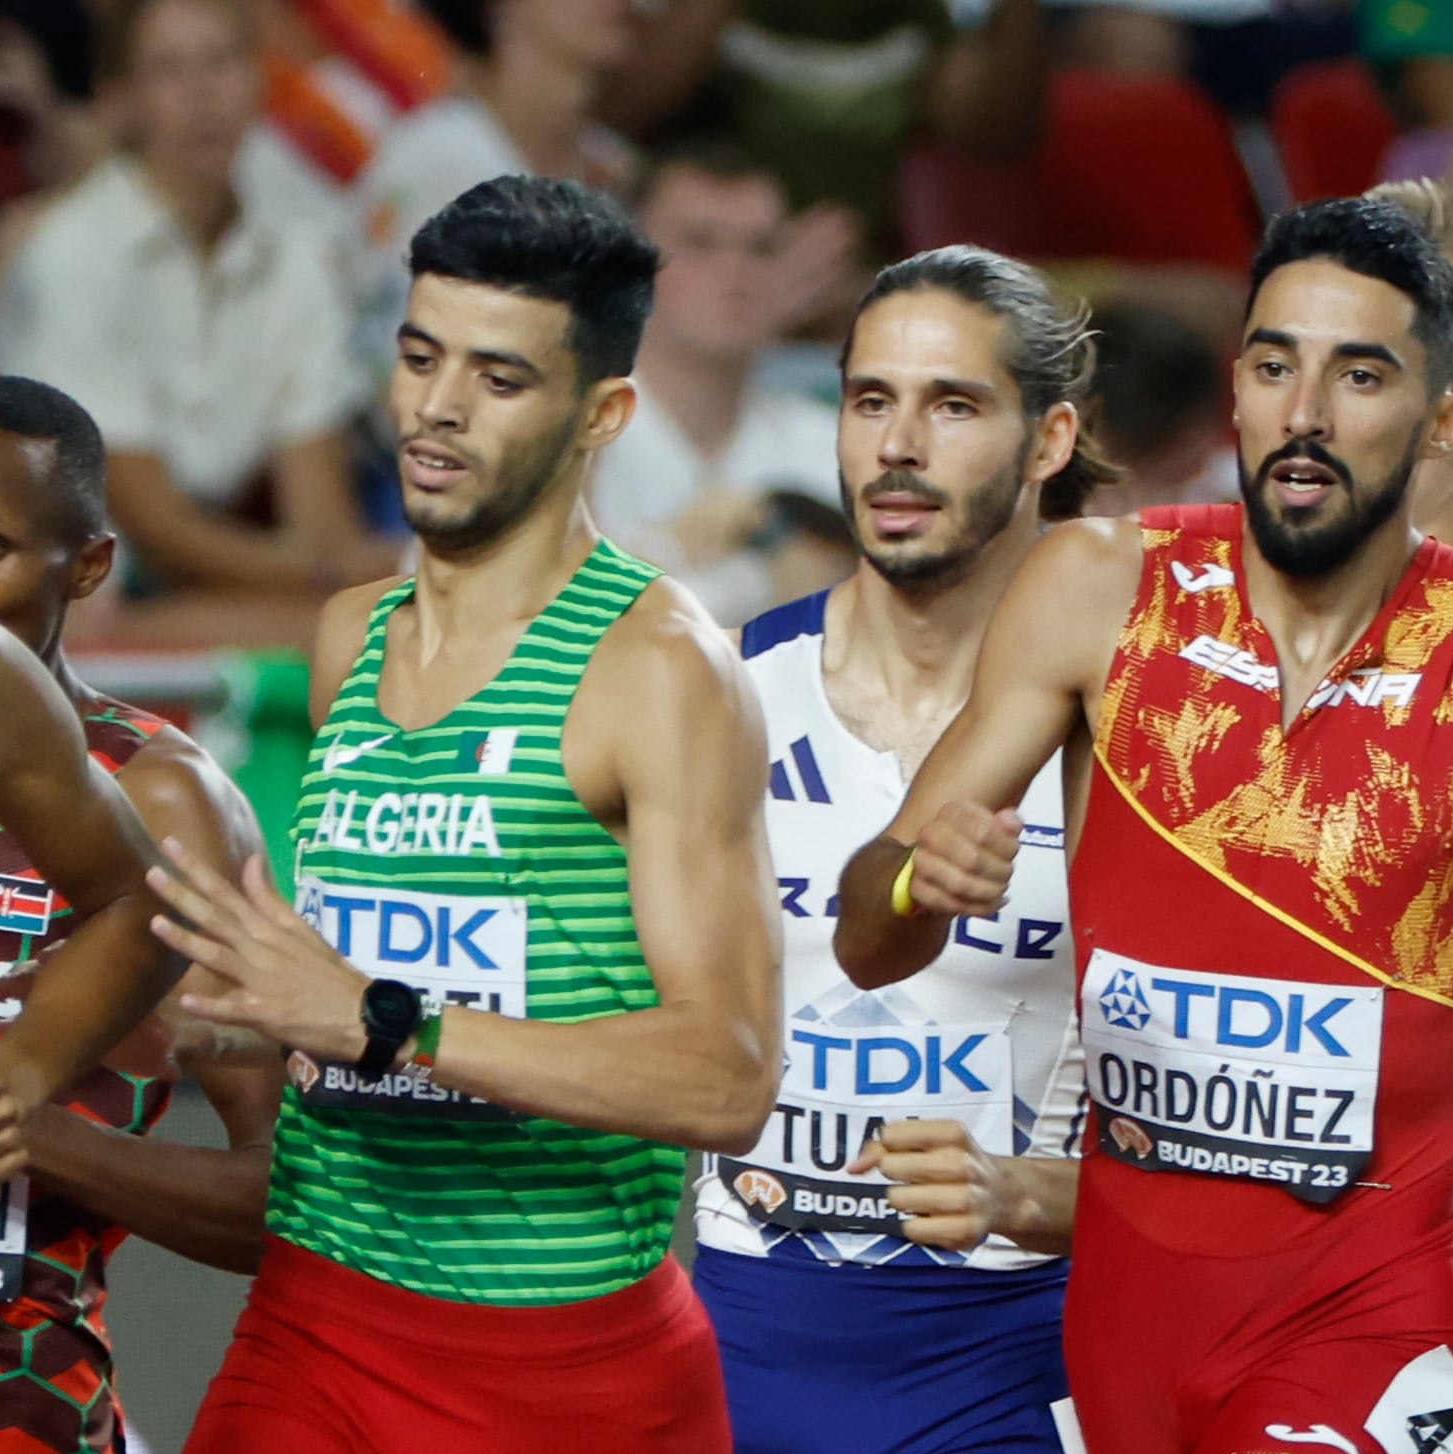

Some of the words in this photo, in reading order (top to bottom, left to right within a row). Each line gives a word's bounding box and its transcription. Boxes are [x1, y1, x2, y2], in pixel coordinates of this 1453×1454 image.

[312, 788, 502, 857] ALGERIA
[322, 896, 501, 970] TDK
[1151, 977, 1355, 1057] TDK
[791, 1029, 992, 1095] TDK
[1100, 1052, 1355, 1145] ORDÓÑEZ
[1157, 1140, 1309, 1184] BUDAPEST
[1311, 1165, 1348, 1187] 23
